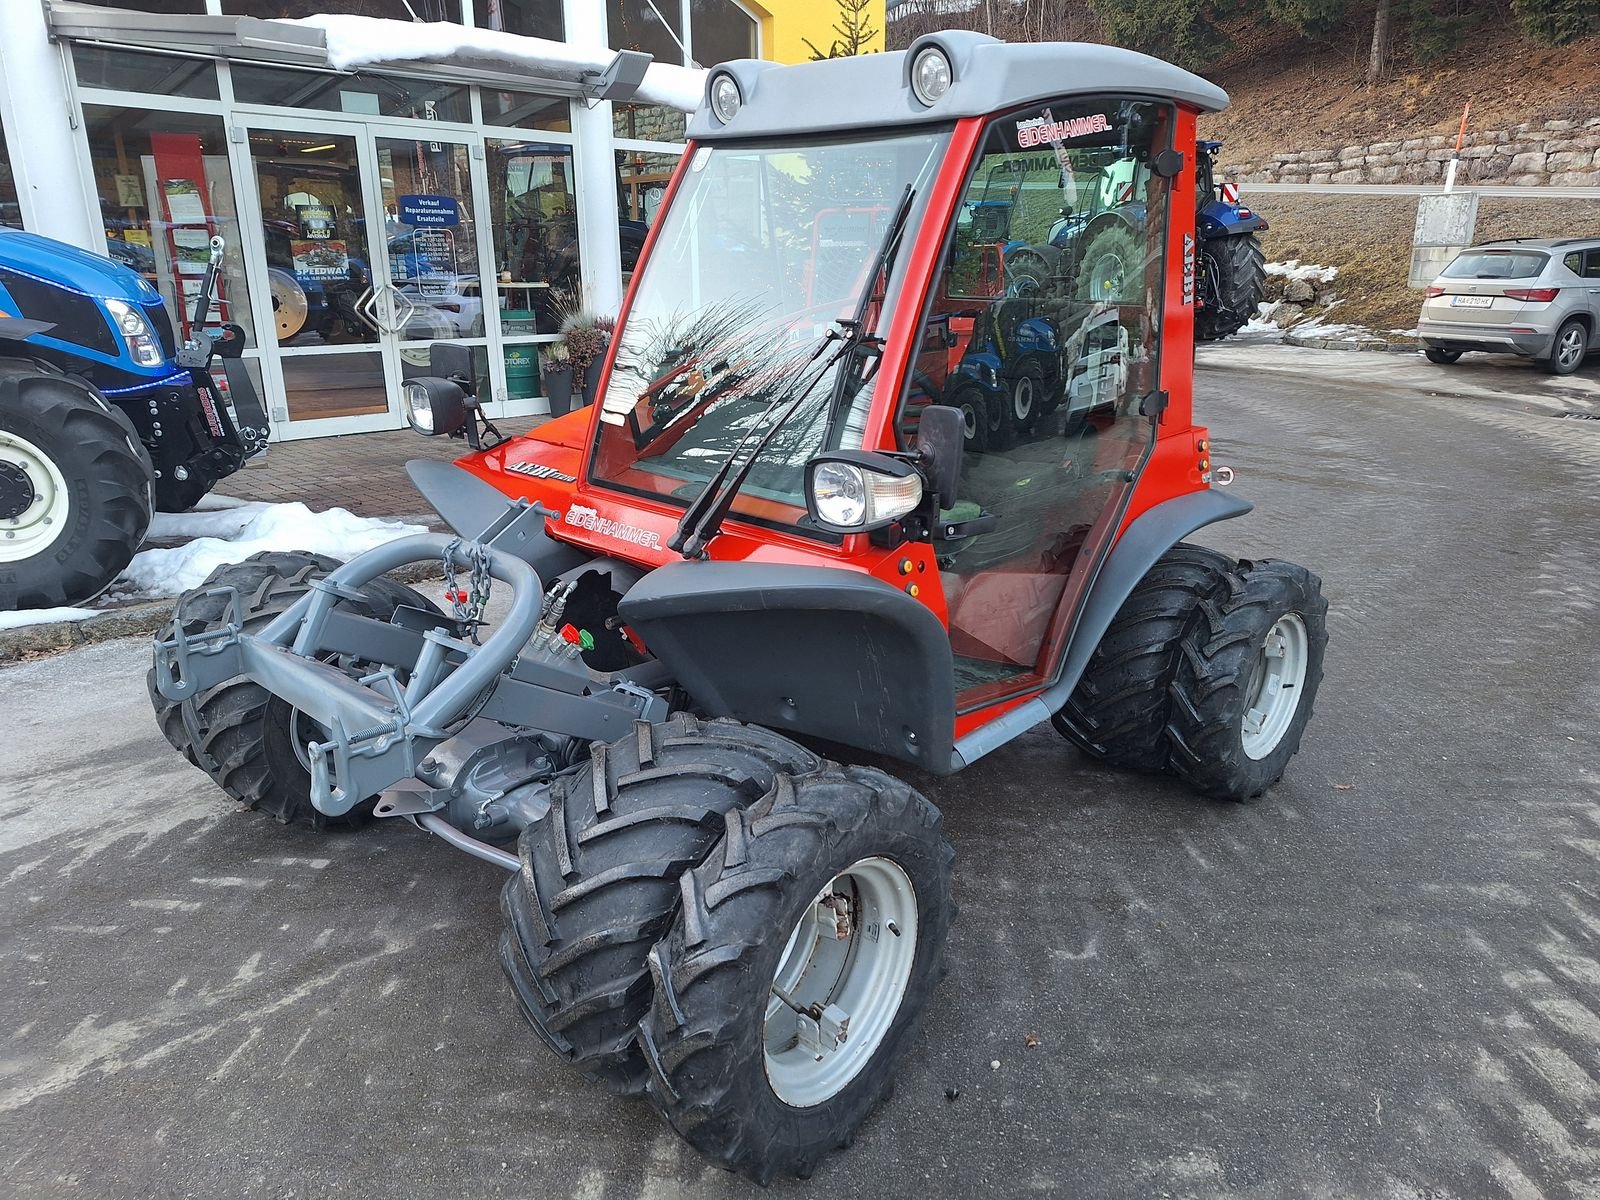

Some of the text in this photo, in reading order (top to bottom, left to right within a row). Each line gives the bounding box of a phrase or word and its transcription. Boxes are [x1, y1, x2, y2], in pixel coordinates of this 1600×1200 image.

[1018, 114, 1107, 148] EIDENHAMMER
[405, 206, 454, 215] Reparaturannahme
[296, 267, 348, 276] SPEEDWAY
[1183, 233, 1195, 306] AEBI
[504, 357, 530, 366] OTOREX
[197, 386, 221, 437] ZUIDBERG
[504, 461, 557, 478] AEBI
[565, 510, 660, 549] EIDENHAMMER
